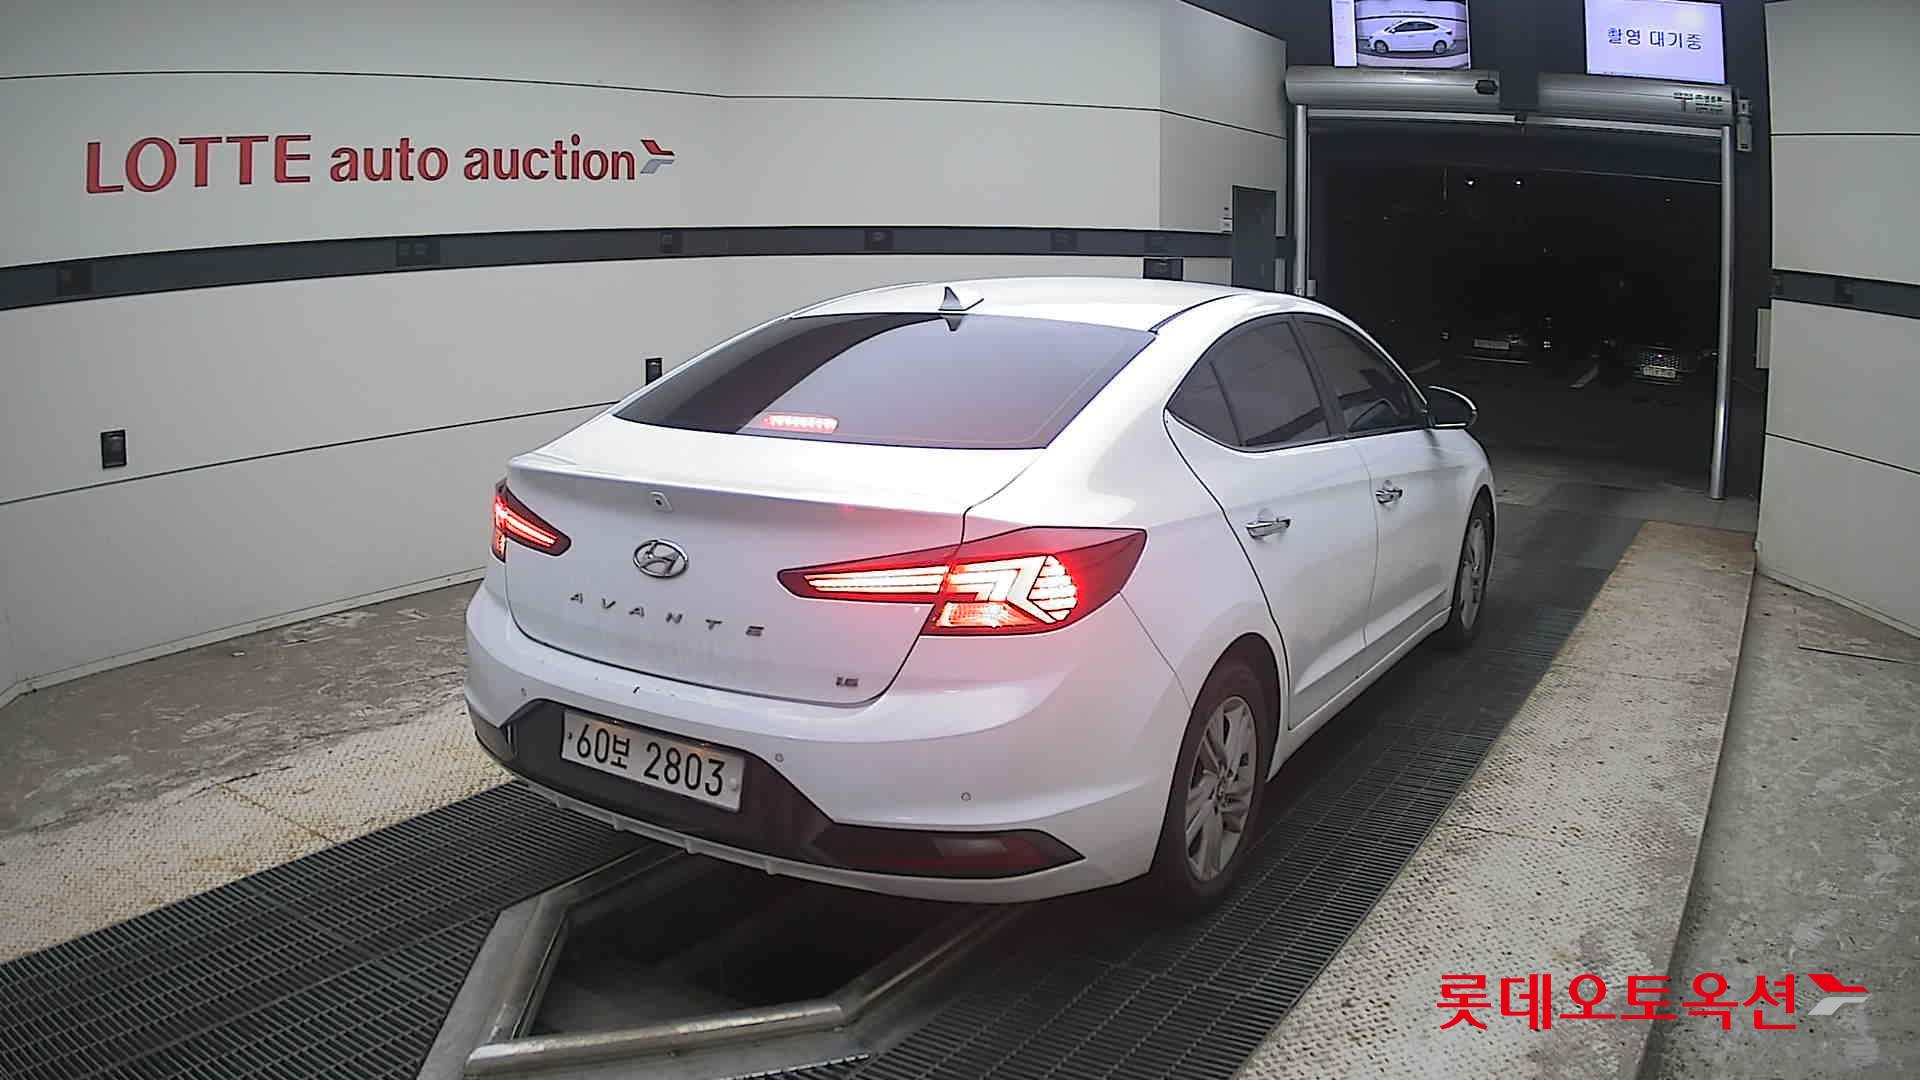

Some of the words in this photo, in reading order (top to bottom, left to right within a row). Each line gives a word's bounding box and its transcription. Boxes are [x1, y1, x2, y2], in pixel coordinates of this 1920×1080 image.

[1649, 30, 1702, 50] 대기중
[87, 135, 311, 194] LOTTE
[330, 137, 449, 182] auto
[464, 134, 636, 181] auction
[570, 592, 765, 637] AVANTE
[576, 723, 631, 770] 60보
[643, 741, 725, 796] 2803
